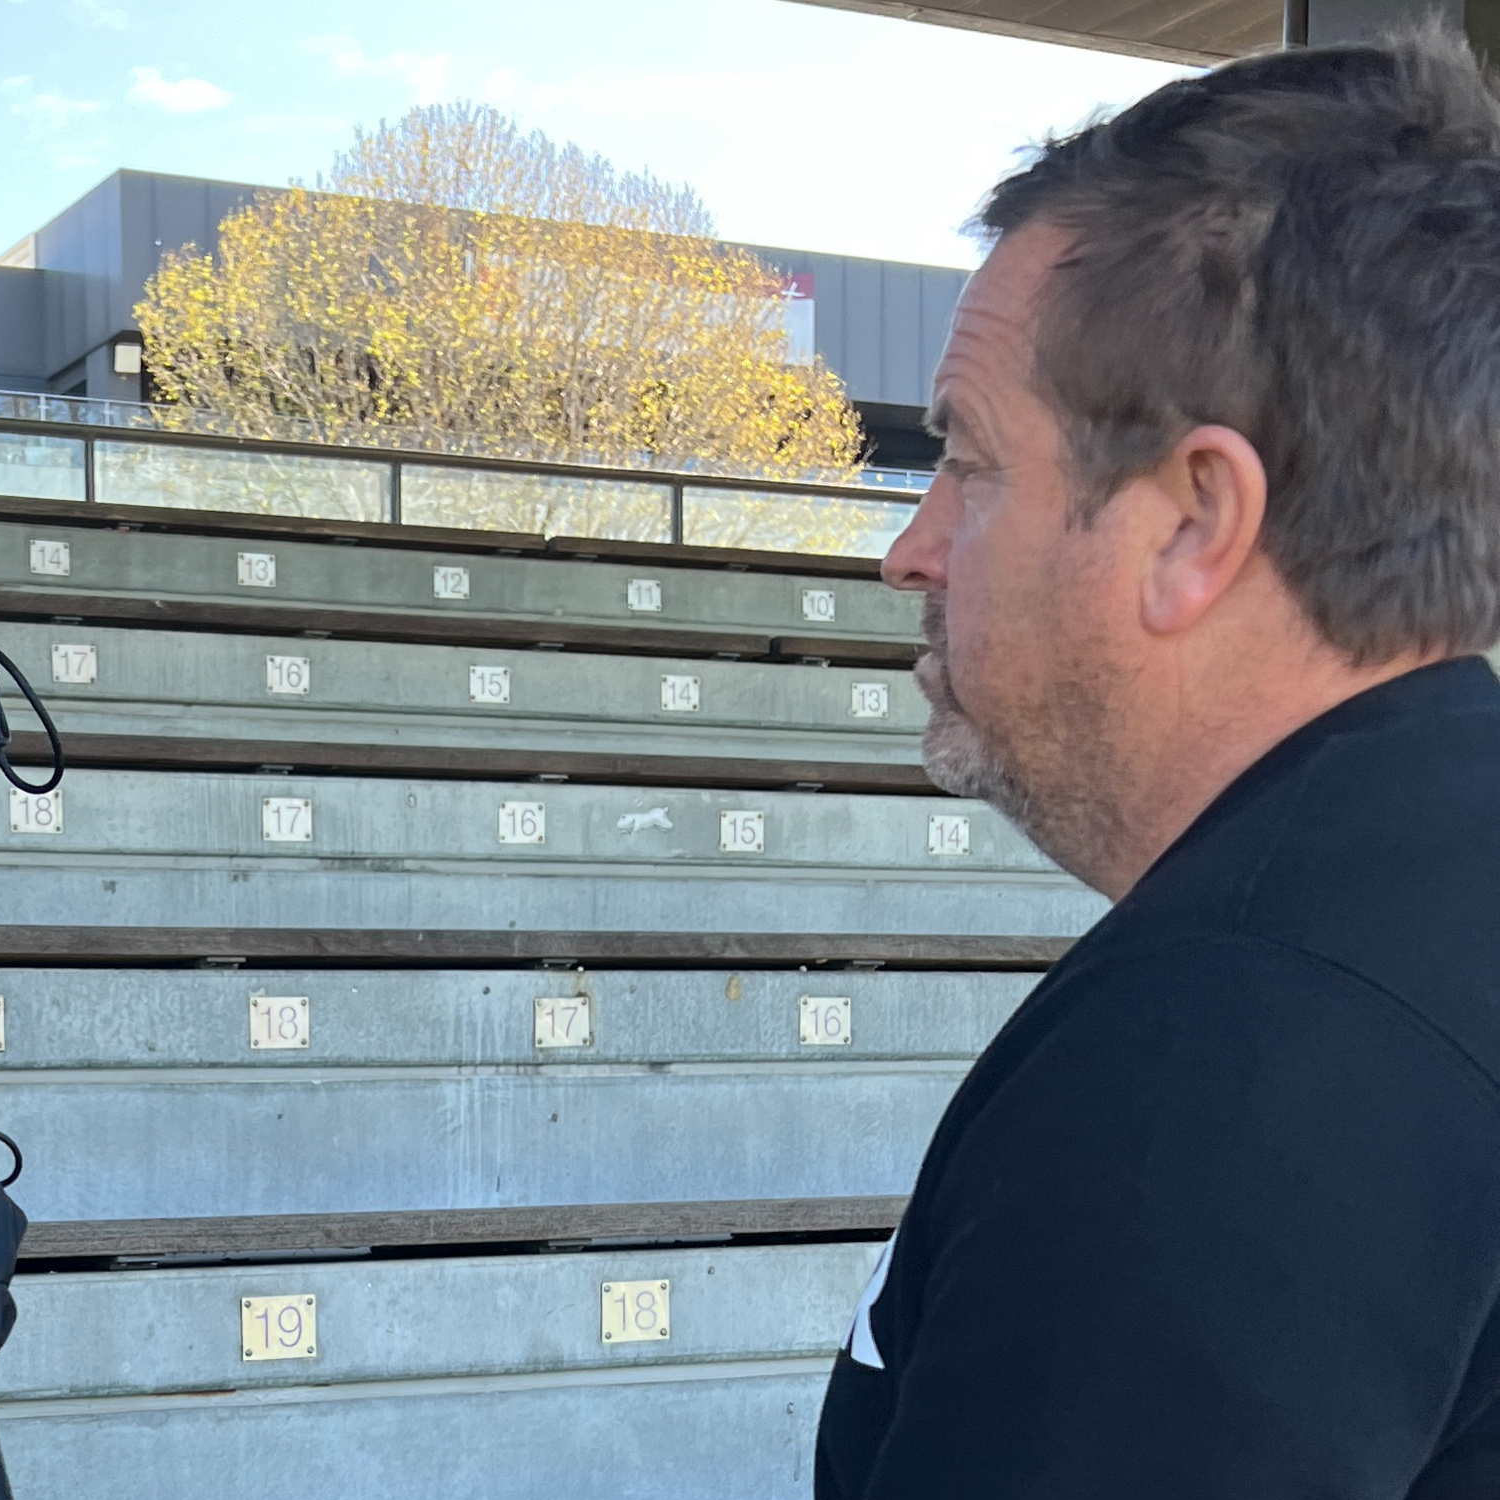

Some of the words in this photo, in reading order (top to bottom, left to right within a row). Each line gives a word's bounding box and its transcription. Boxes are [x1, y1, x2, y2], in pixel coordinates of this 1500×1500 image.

[38, 546, 62, 569] 14
[244, 558, 269, 582] 13
[440, 571, 463, 594] 12
[634, 584, 654, 605] 11
[807, 595, 829, 617] 10
[59, 651, 89, 677] 17
[273, 662, 303, 688] 16
[476, 672, 503, 698] 15
[668, 681, 692, 705] 14
[858, 688, 881, 713] 13
[19, 796, 53, 827] 18
[271, 805, 302, 834] 17
[507, 808, 537, 837] 16
[729, 817, 756, 845] 15
[936, 822, 962, 849] 14
[260, 1005, 298, 1040] 18
[545, 1005, 579, 1039] 17
[809, 1005, 842, 1038] 16
[613, 1290, 657, 1332] 18
[255, 1305, 303, 1349] 19
